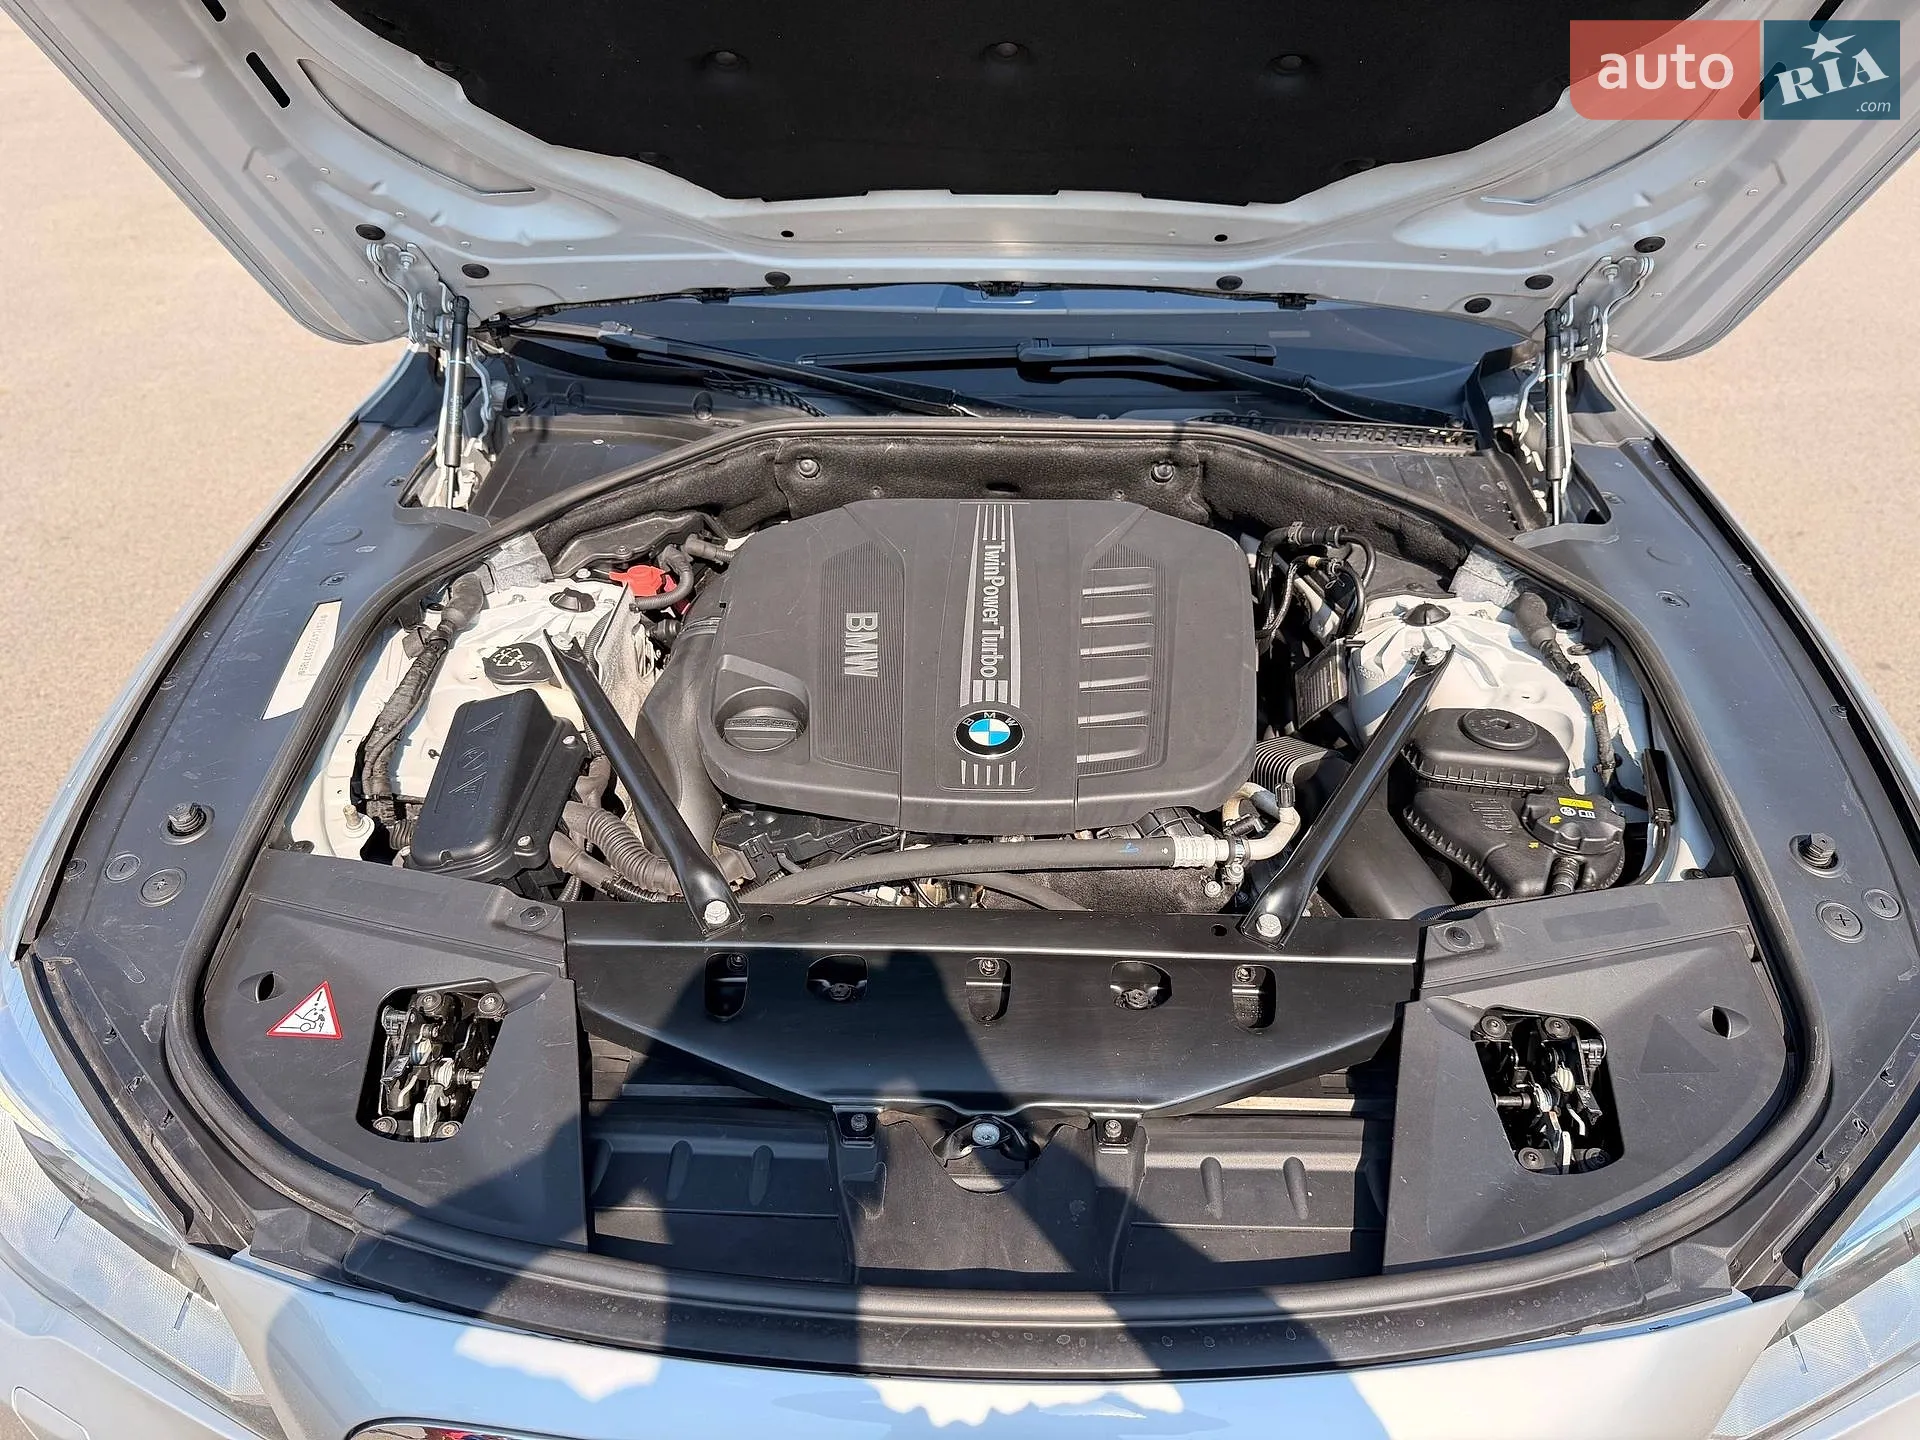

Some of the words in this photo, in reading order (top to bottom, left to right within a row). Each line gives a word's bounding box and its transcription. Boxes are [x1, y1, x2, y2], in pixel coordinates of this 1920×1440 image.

[982, 541, 1006, 625] TwinPower
[844, 612, 879, 678] BMW
[980, 626, 1005, 678] Turbo
[962, 712, 1019, 727] BMW
